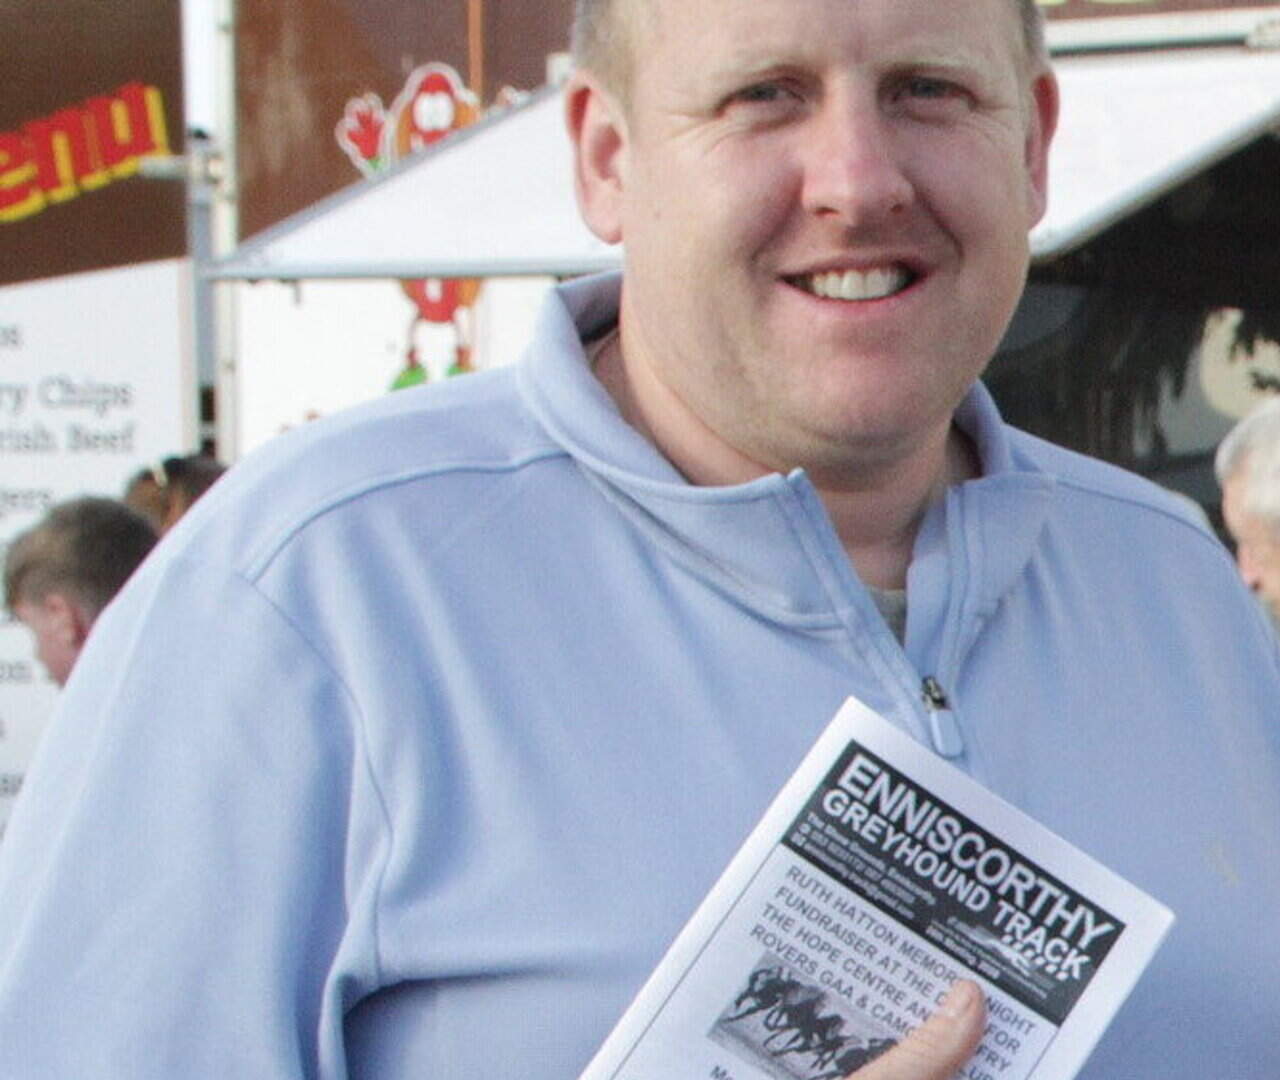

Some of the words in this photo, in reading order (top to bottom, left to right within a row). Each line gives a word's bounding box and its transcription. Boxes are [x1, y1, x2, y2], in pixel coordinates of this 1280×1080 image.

[0, 78, 172, 224] enu
[820, 787, 993, 915] GREYHOUND
[986, 899, 1091, 981] TRACK
[835, 753, 1115, 953] ENNISCORTHY
[749, 921, 820, 977] ROVERS
[817, 966, 858, 1001] GAA
[853, 991, 873, 1011] &
[759, 901, 797, 934] THE
[793, 924, 844, 966] HOPE
[840, 955, 907, 1007] CENTRE
[904, 997, 934, 1025] AN
[973, 1043, 1011, 1076] FRY
[773, 884, 879, 962] FUNDRAISER
[876, 952, 904, 978] AT
[898, 967, 937, 1000] THE
[983, 1023, 1022, 1057] FOR
[784, 864, 834, 905] RUTH
[830, 895, 900, 948] HATTON
[896, 938, 961, 990] MEMOR
[983, 996, 1037, 1039] NIGHT
